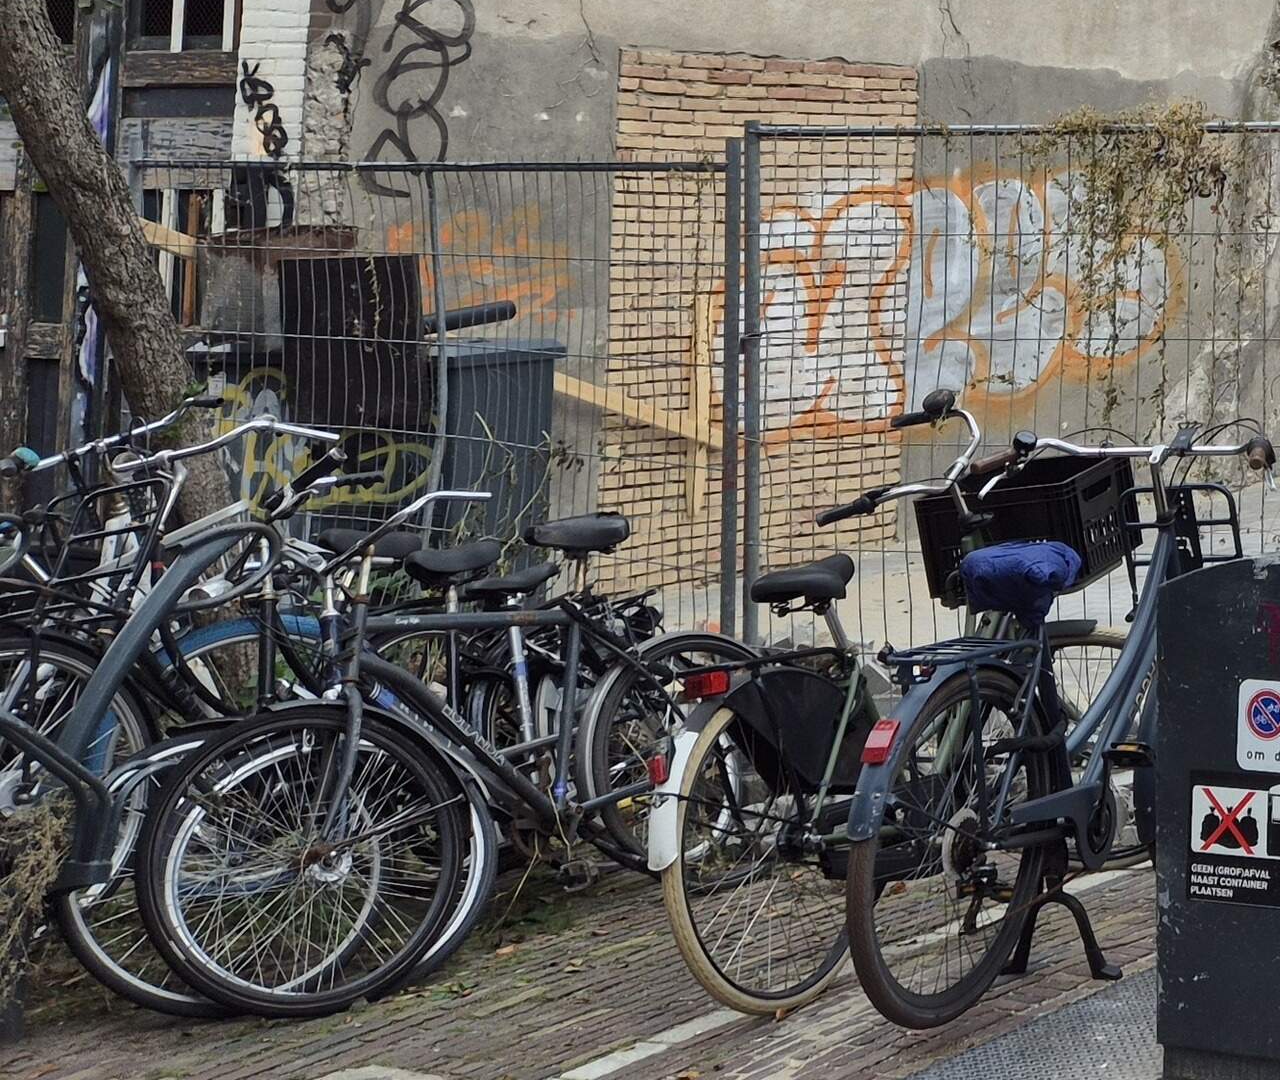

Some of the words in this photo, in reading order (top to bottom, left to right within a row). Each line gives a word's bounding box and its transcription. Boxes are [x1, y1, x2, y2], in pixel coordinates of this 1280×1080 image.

[1246, 750, 1265, 761] om
[1191, 863, 1214, 874] GEEN
[1215, 865, 1271, 880] (GROF)AFVAL
[1190, 874, 1218, 885] NAAST
[1219, 877, 1268, 890] CONTAINER
[1190, 885, 1233, 898] PLAATSEN
